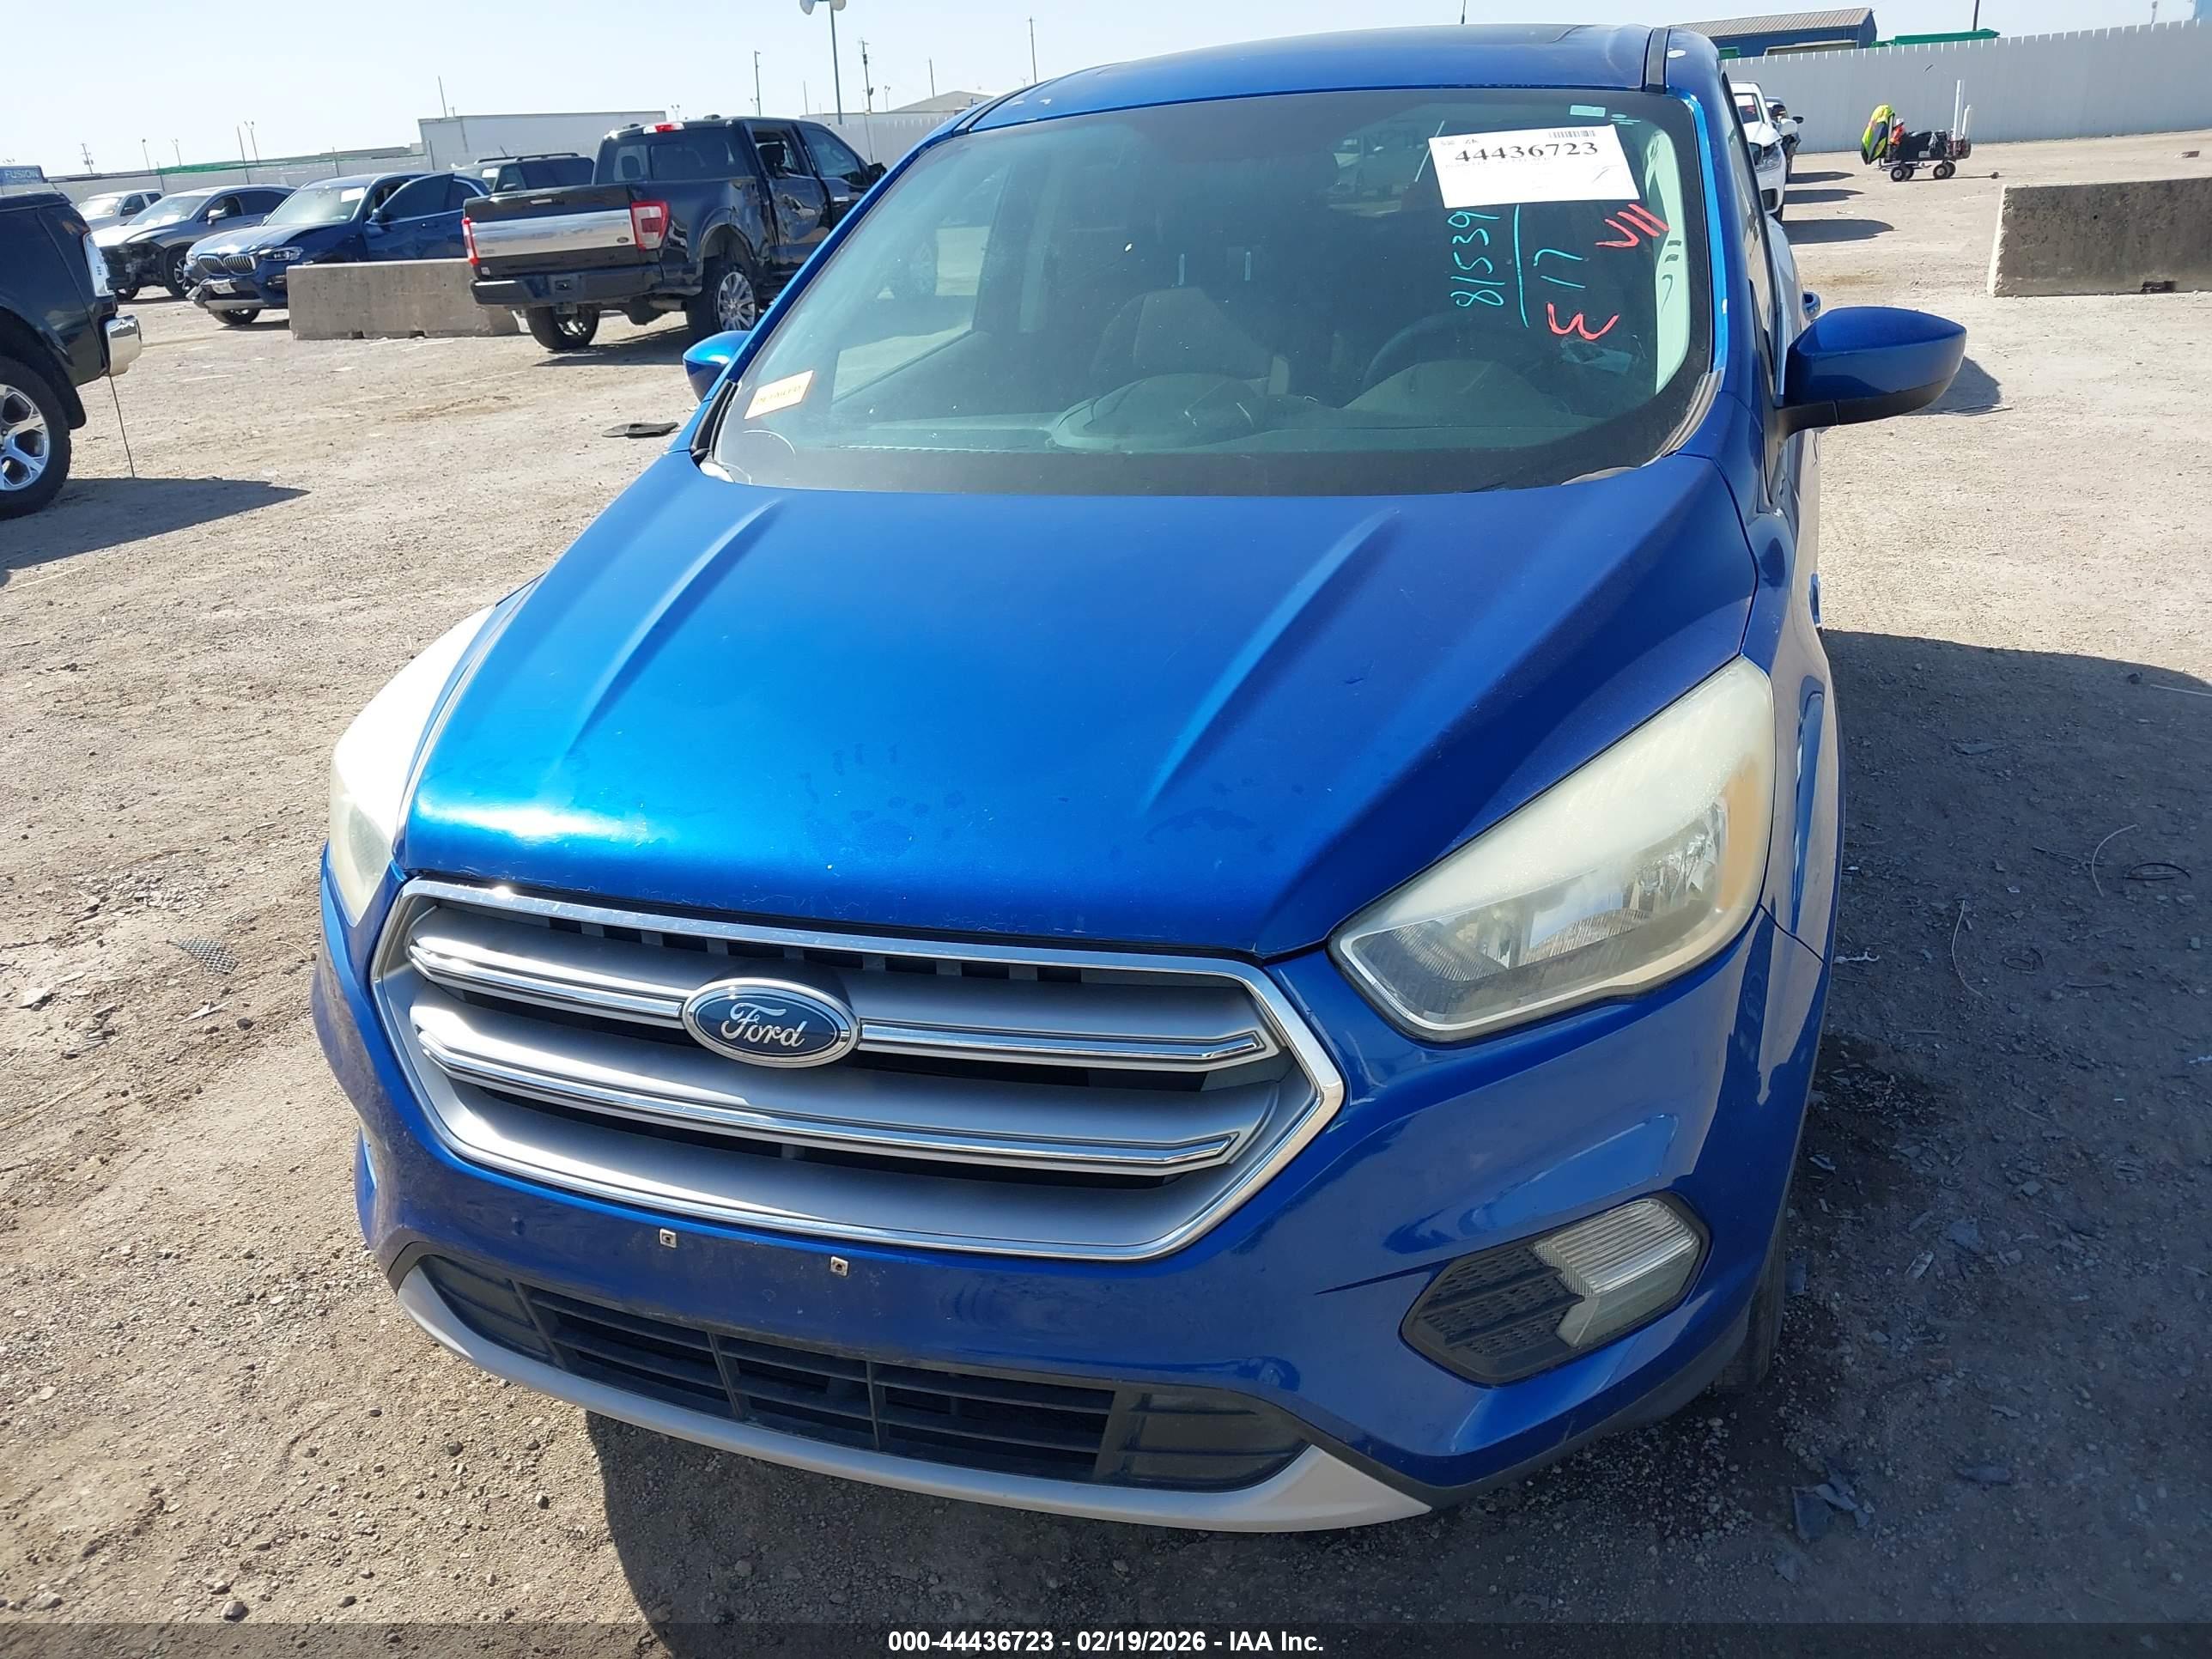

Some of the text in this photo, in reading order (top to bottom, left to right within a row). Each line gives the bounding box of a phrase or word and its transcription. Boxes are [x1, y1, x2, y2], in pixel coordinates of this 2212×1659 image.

[1455, 143, 1599, 162] 44436723
[1447, 210, 1505, 308] 81539
[720, 1002, 808, 1048] Ford
